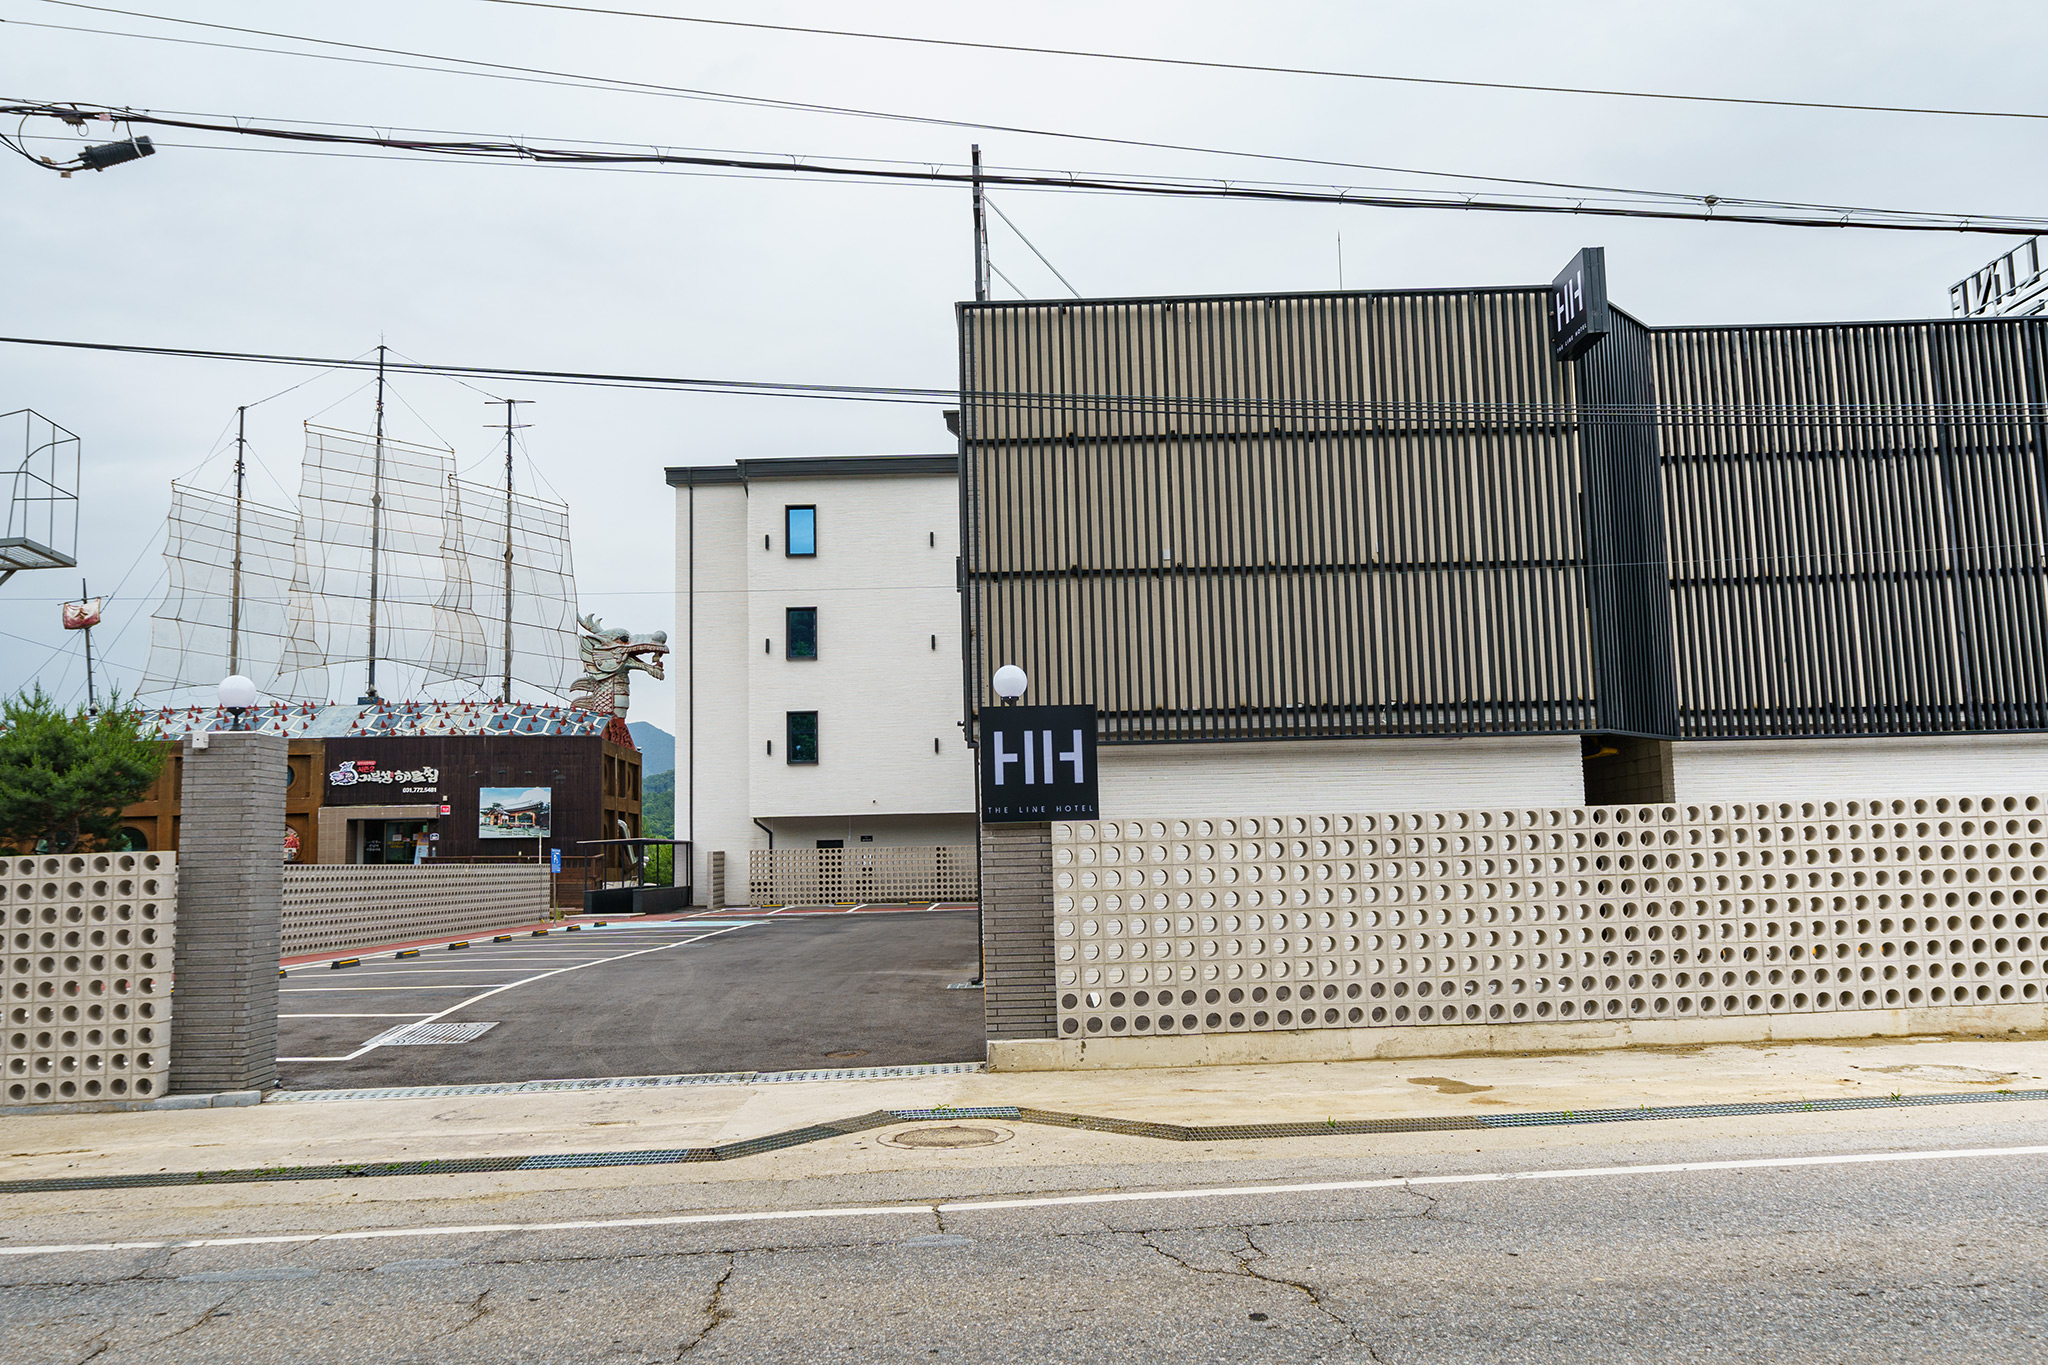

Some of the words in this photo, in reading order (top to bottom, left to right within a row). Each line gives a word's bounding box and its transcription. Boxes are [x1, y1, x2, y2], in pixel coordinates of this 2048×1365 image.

[987, 806, 1009, 814] THE
[1018, 805, 1046, 813] LINE
[1055, 804, 1094, 812] HOTEL
